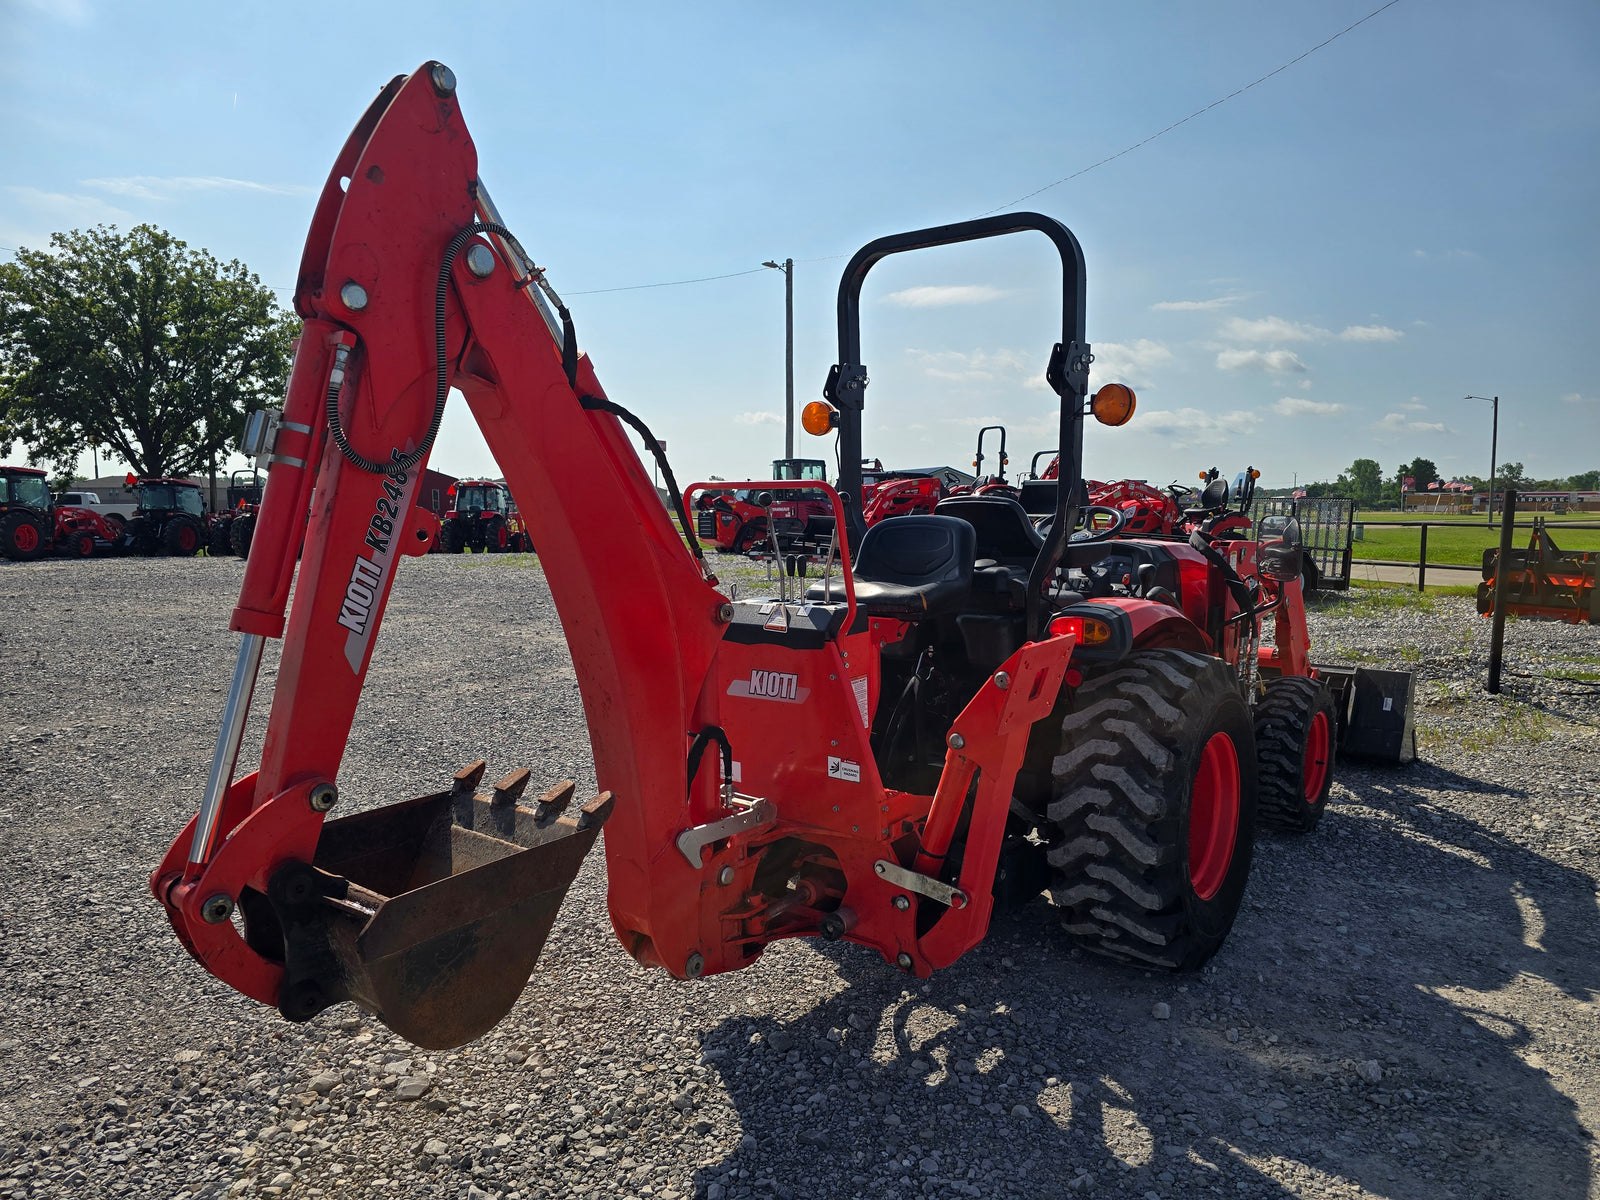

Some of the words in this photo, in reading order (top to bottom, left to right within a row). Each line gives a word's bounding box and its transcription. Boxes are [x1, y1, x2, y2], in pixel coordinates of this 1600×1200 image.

[337, 555, 383, 635] KIOTI
[364, 447, 411, 554] KB2485
[749, 669, 799, 700] KIOTI
